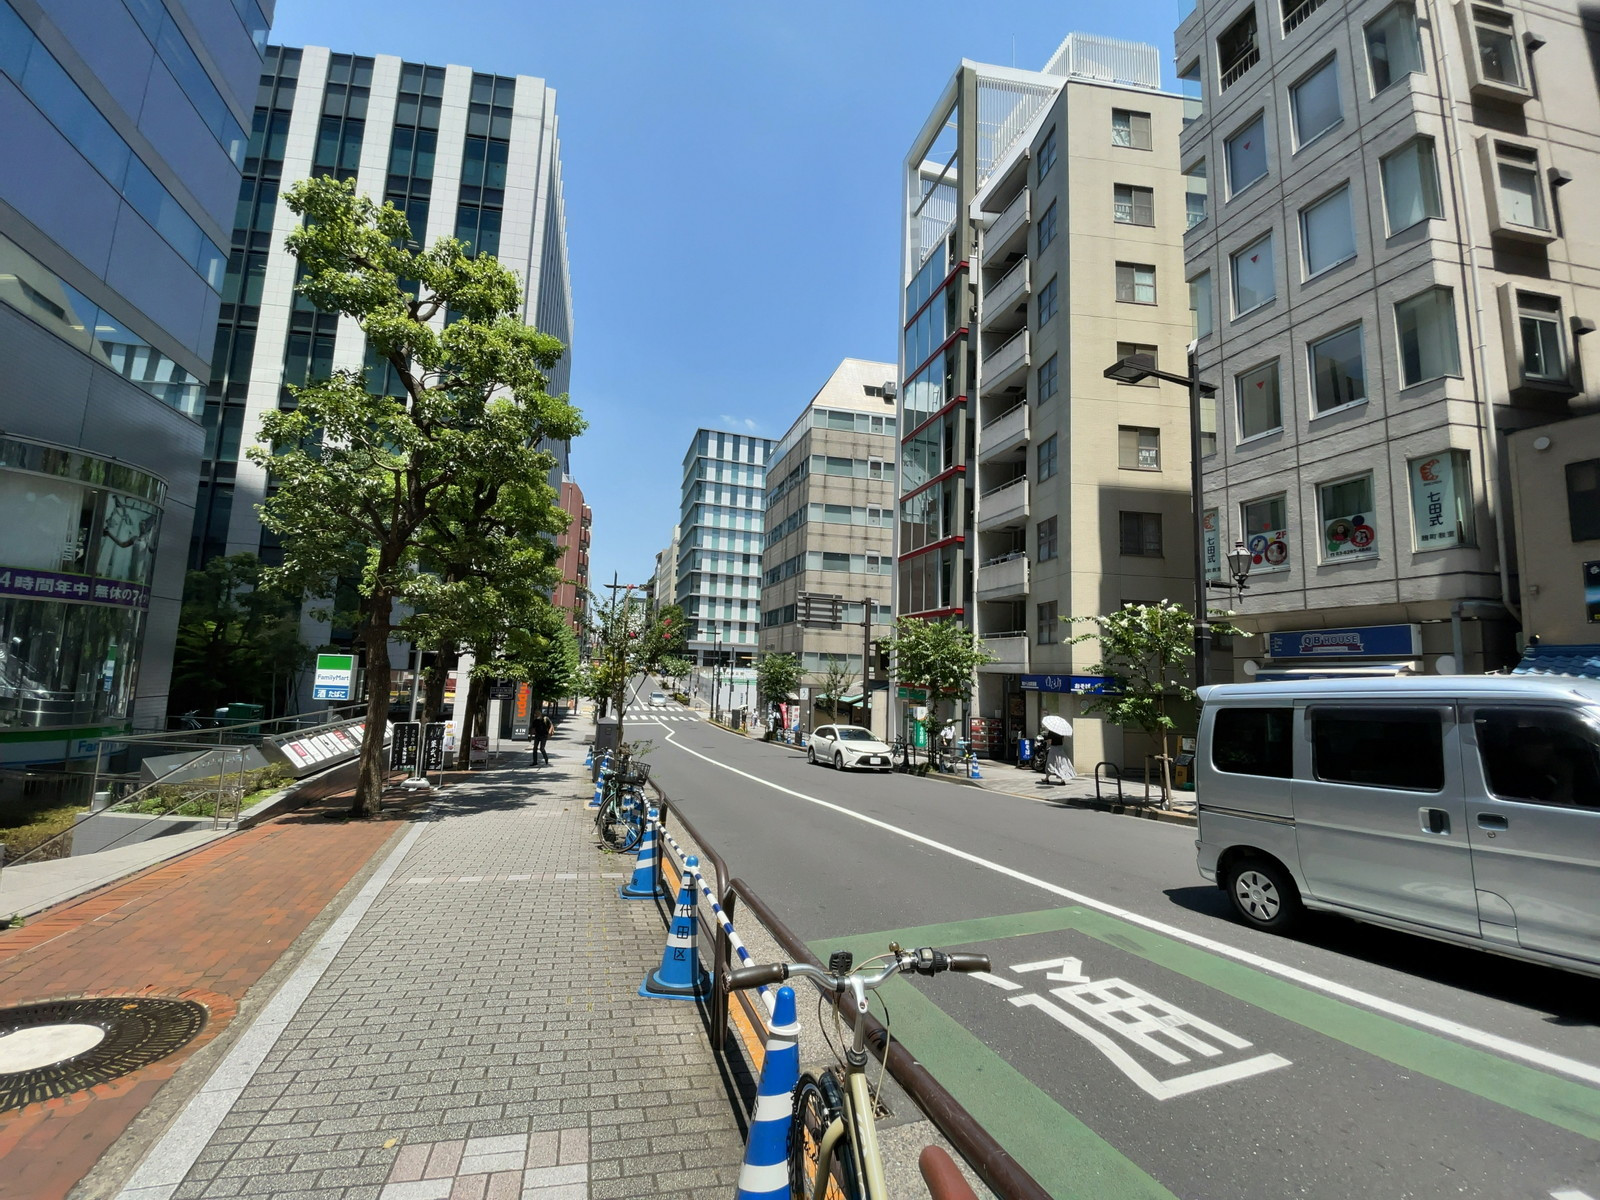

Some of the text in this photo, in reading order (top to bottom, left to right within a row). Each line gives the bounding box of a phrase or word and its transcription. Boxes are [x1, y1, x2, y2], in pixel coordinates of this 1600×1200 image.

[1427, 491, 1443, 527] 七田式
[1275, 530, 1287, 540] 2F
[1206, 537, 1216, 564] 七田式
[1303, 634, 1358, 646] QB HOUSE
[317, 673, 349, 682] FamilyMart
[328, 690, 346, 698] たばこ
[673, 883, 694, 961] 千代田区
